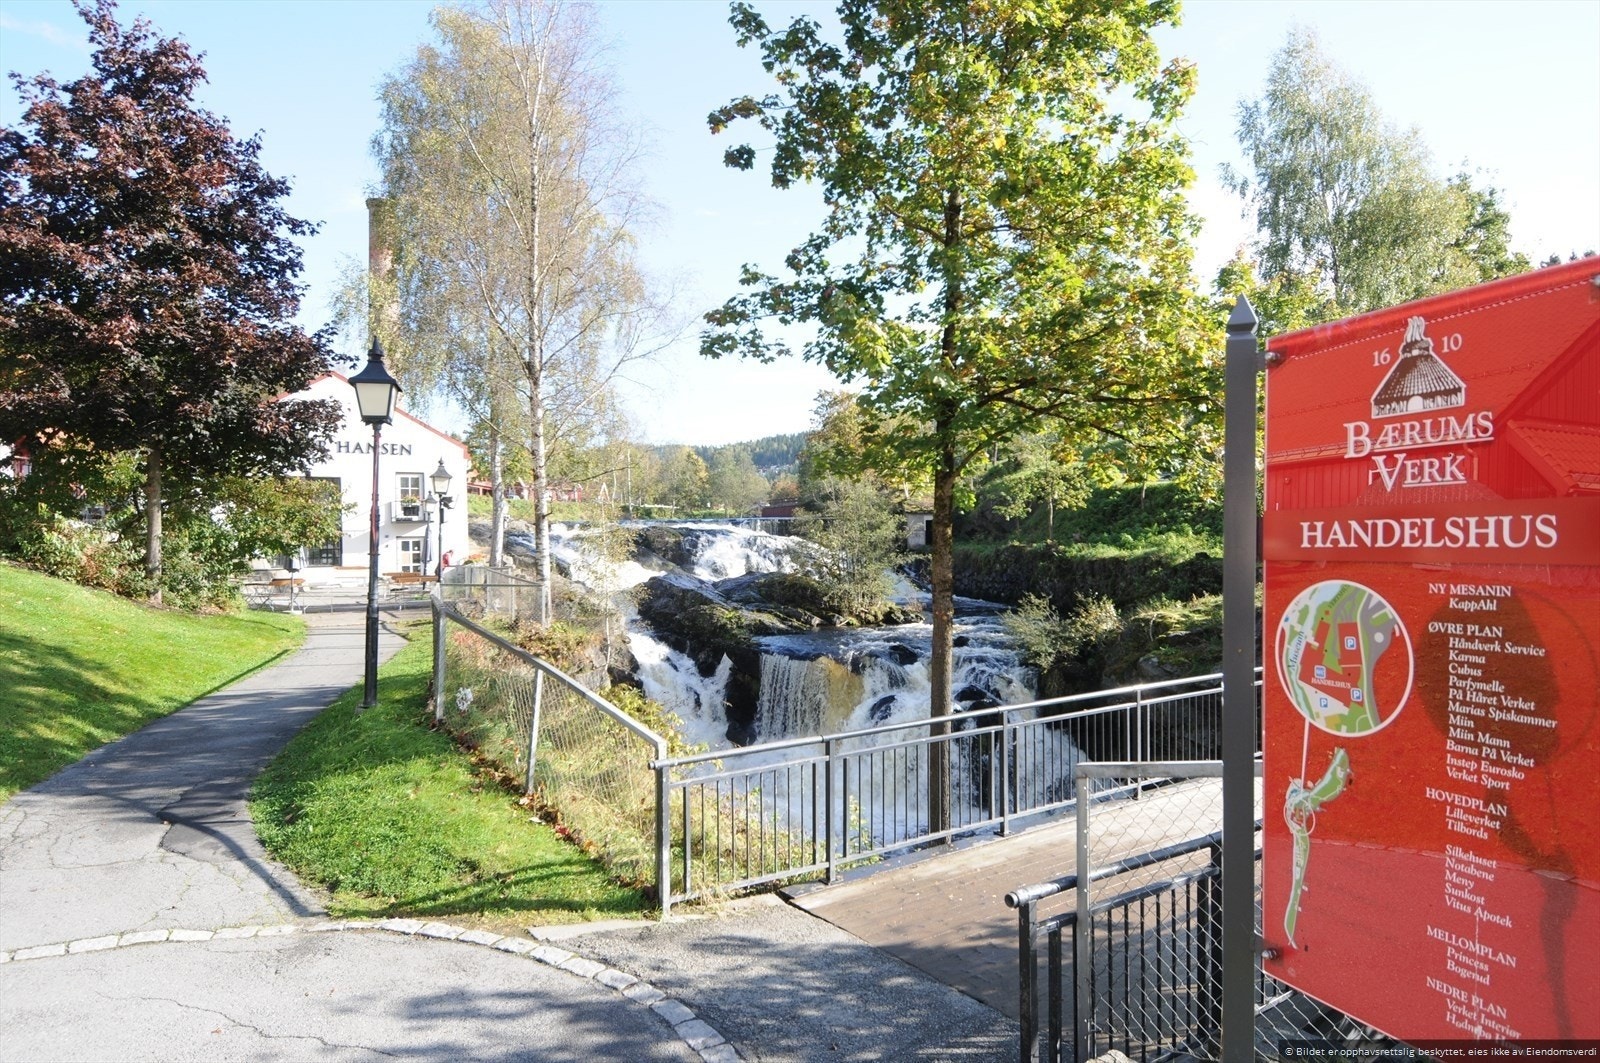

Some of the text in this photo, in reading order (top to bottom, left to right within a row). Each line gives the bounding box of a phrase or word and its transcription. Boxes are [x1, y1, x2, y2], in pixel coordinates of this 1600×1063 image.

[1441, 333, 1462, 353] 10
[1372, 349, 1390, 367] 16
[1343, 410, 1494, 459] BÆRUMS
[1371, 453, 1466, 492] VERK
[1299, 513, 1558, 548] HANDELSHUS
[1428, 583, 1512, 596] NY MESANIN
[1449, 597, 1497, 611] KappAhl
[1428, 622, 1503, 638] ØVRE PLAN
[1449, 637, 1546, 657] Håndverk Service
[1449, 650, 1486, 664] Karma
[1448, 664, 1482, 676] Cubus
[1448, 676, 1505, 693] Parfymelle
[1448, 688, 1536, 711] På Håret Verket
[1448, 701, 1558, 728] Marias Spiskammer
[1448, 714, 1475, 728] Miin
[1448, 727, 1511, 749] Miin Mann
[1446, 739, 1535, 768] Barna På Verket
[1446, 753, 1525, 780] Instep Eurosko
[1446, 766, 1510, 790] Verket Sport
[1425, 787, 1508, 817] HOVEDPLAN
[1445, 806, 1501, 830] Lilleverket
[1445, 819, 1489, 840] Tilbords
[1445, 844, 1497, 869] Silkehuset
[1445, 857, 1495, 882] Notabene
[1445, 869, 1475, 889] Meny
[1445, 883, 1485, 905] Sunkost
[1444, 895, 1513, 928] Vitus Apotek
[1426, 925, 1517, 968] MELLOMPLAN
[1446, 946, 1489, 972] Princess
[1446, 960, 1490, 986] Bogerud
[1426, 976, 1507, 1019] NEDRE PLAN
[1446, 998, 1478, 1020] Verket
[1446, 1011, 1492, 1040] Hodnbo
